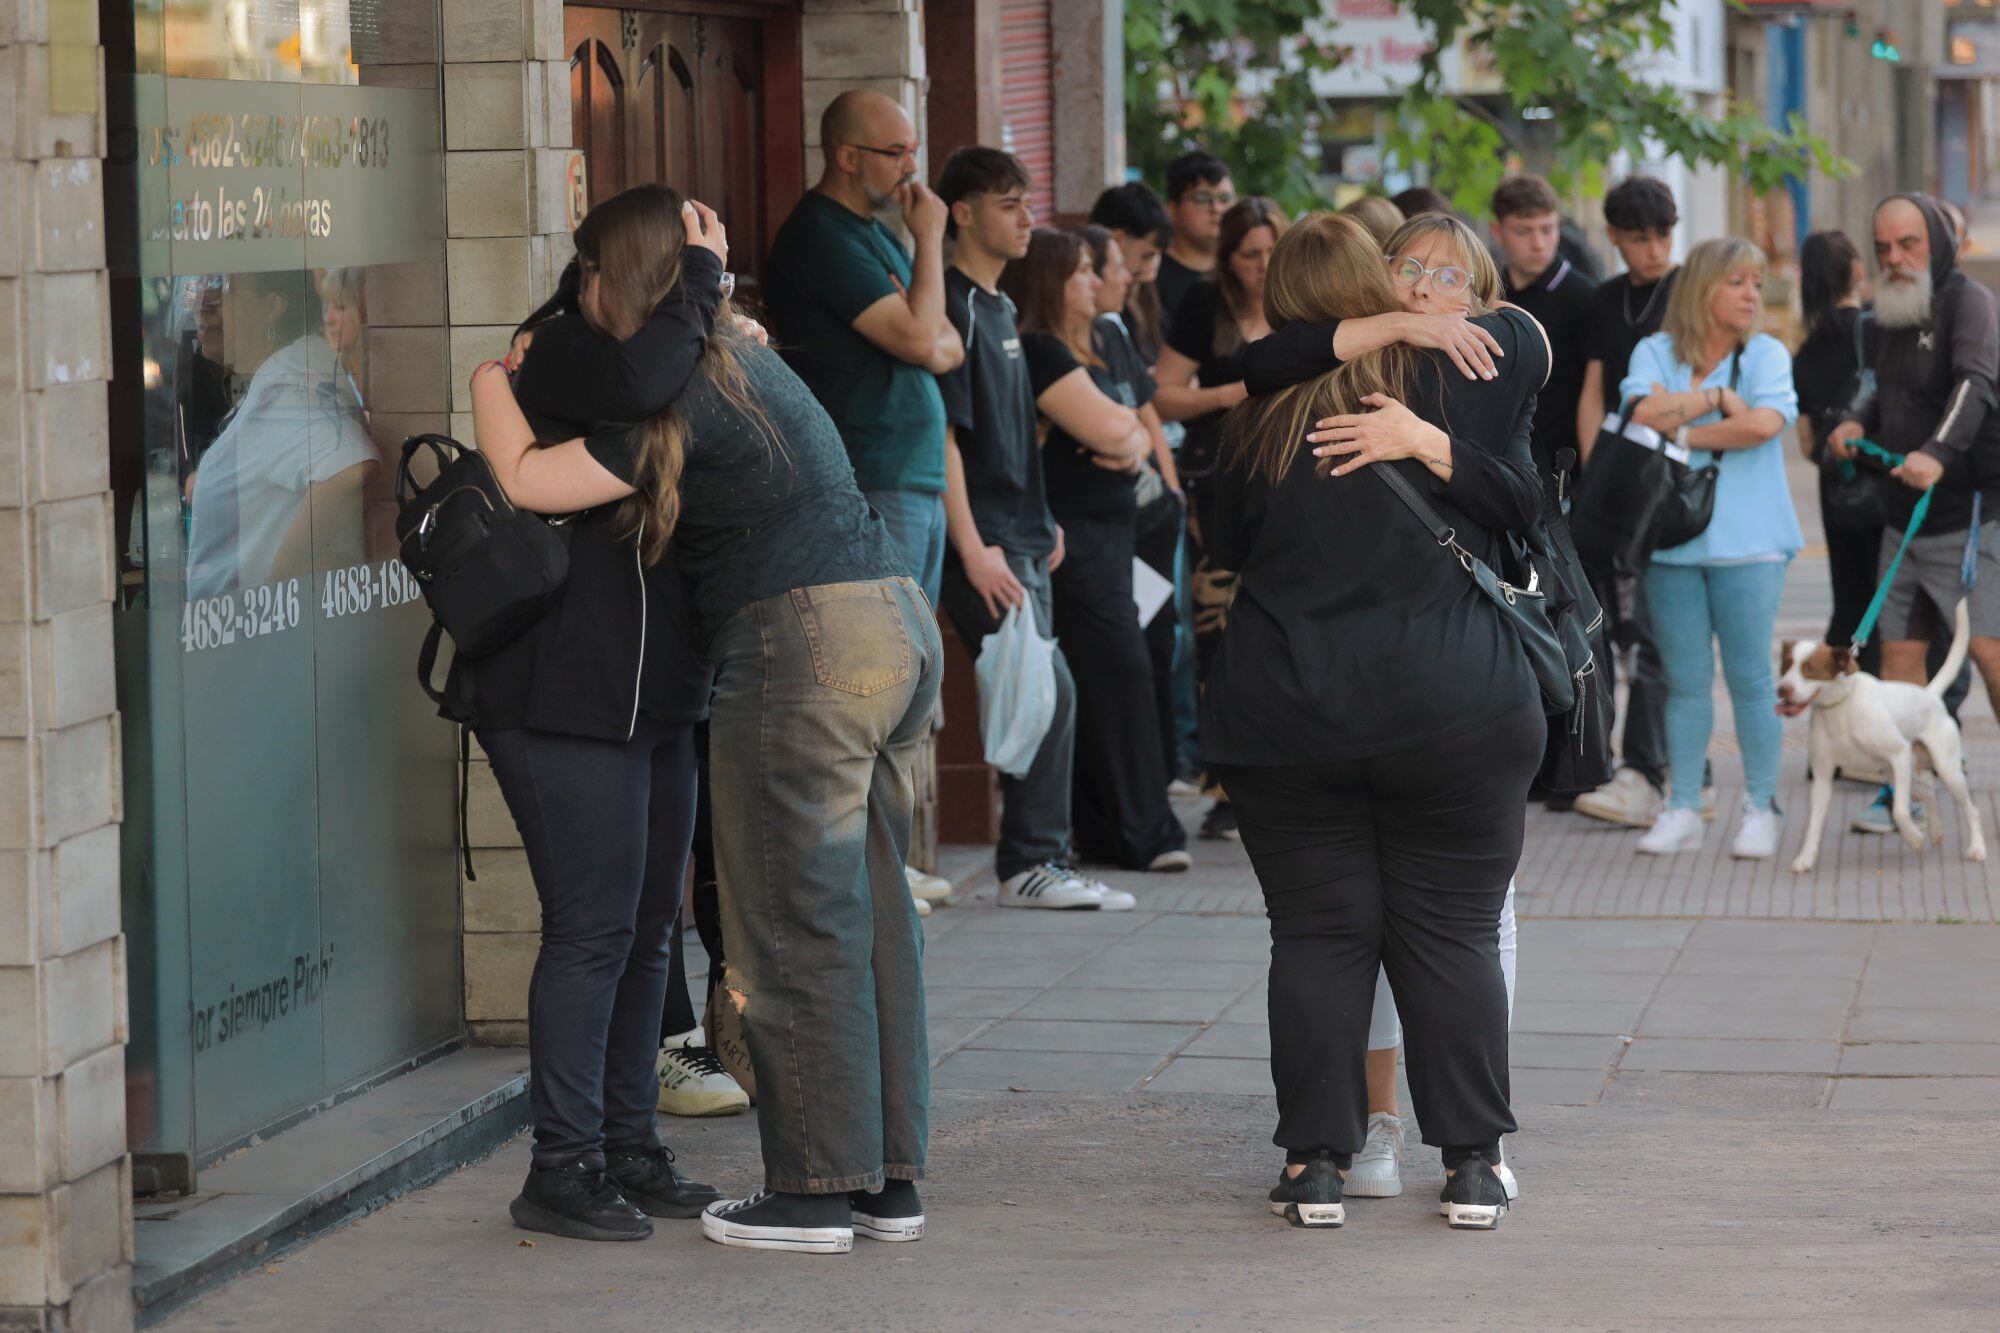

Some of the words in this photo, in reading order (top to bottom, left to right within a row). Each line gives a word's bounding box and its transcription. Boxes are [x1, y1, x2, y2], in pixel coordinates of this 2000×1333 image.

[218, 186, 247, 241] las
[252, 186, 273, 240] 24
[281, 186, 331, 238] horas
[181, 578, 300, 652] 4682-3246
[218, 976, 289, 1043] siempre
